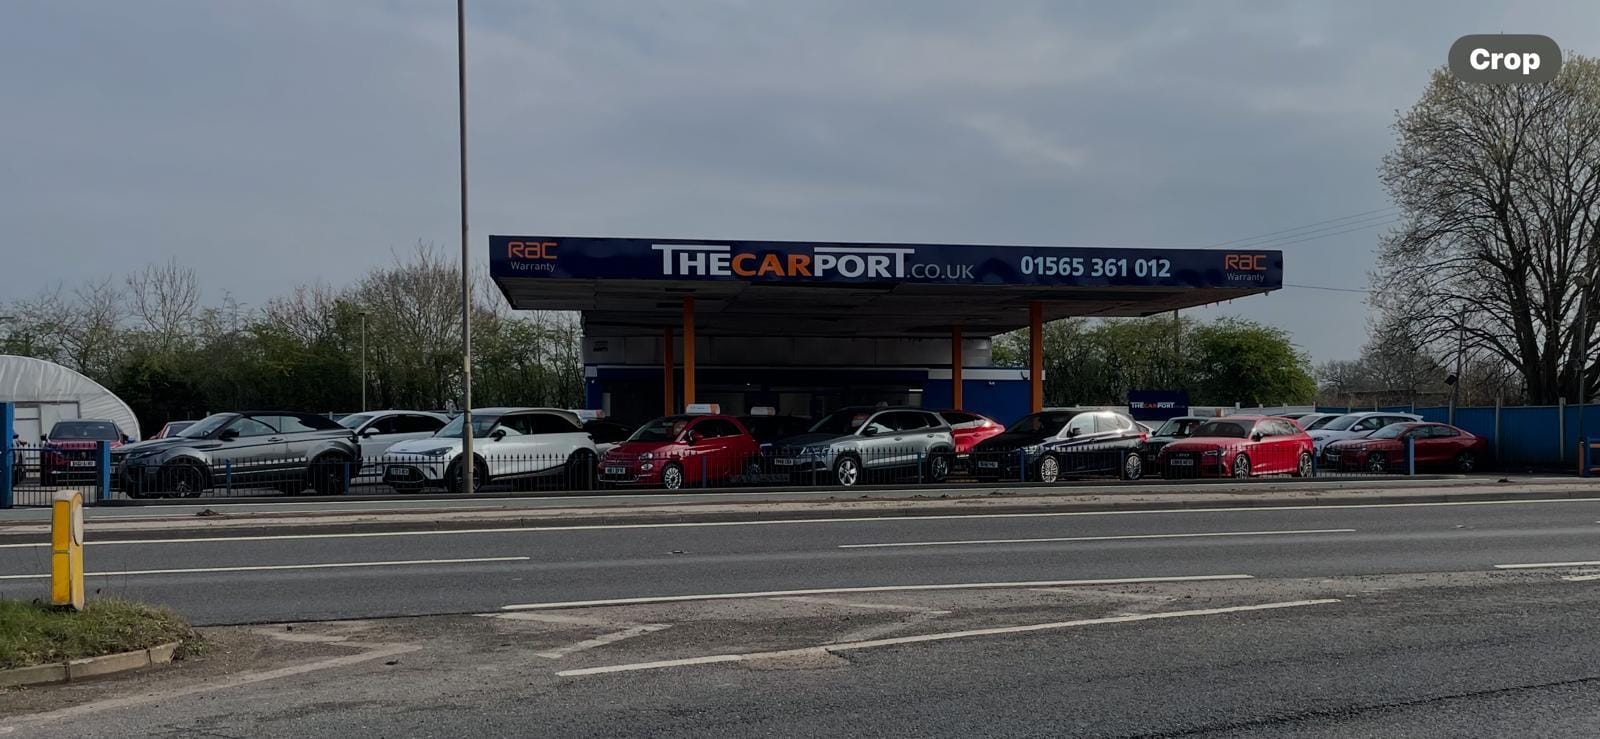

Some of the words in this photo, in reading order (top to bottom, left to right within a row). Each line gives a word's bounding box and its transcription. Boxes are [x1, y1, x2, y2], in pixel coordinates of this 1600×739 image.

[510, 261, 556, 272] Warranty
[1020, 255, 1083, 276] 01565
[1091, 257, 1128, 277] 361
[1134, 258, 1171, 278] 012
[1227, 272, 1265, 283] Warranty
